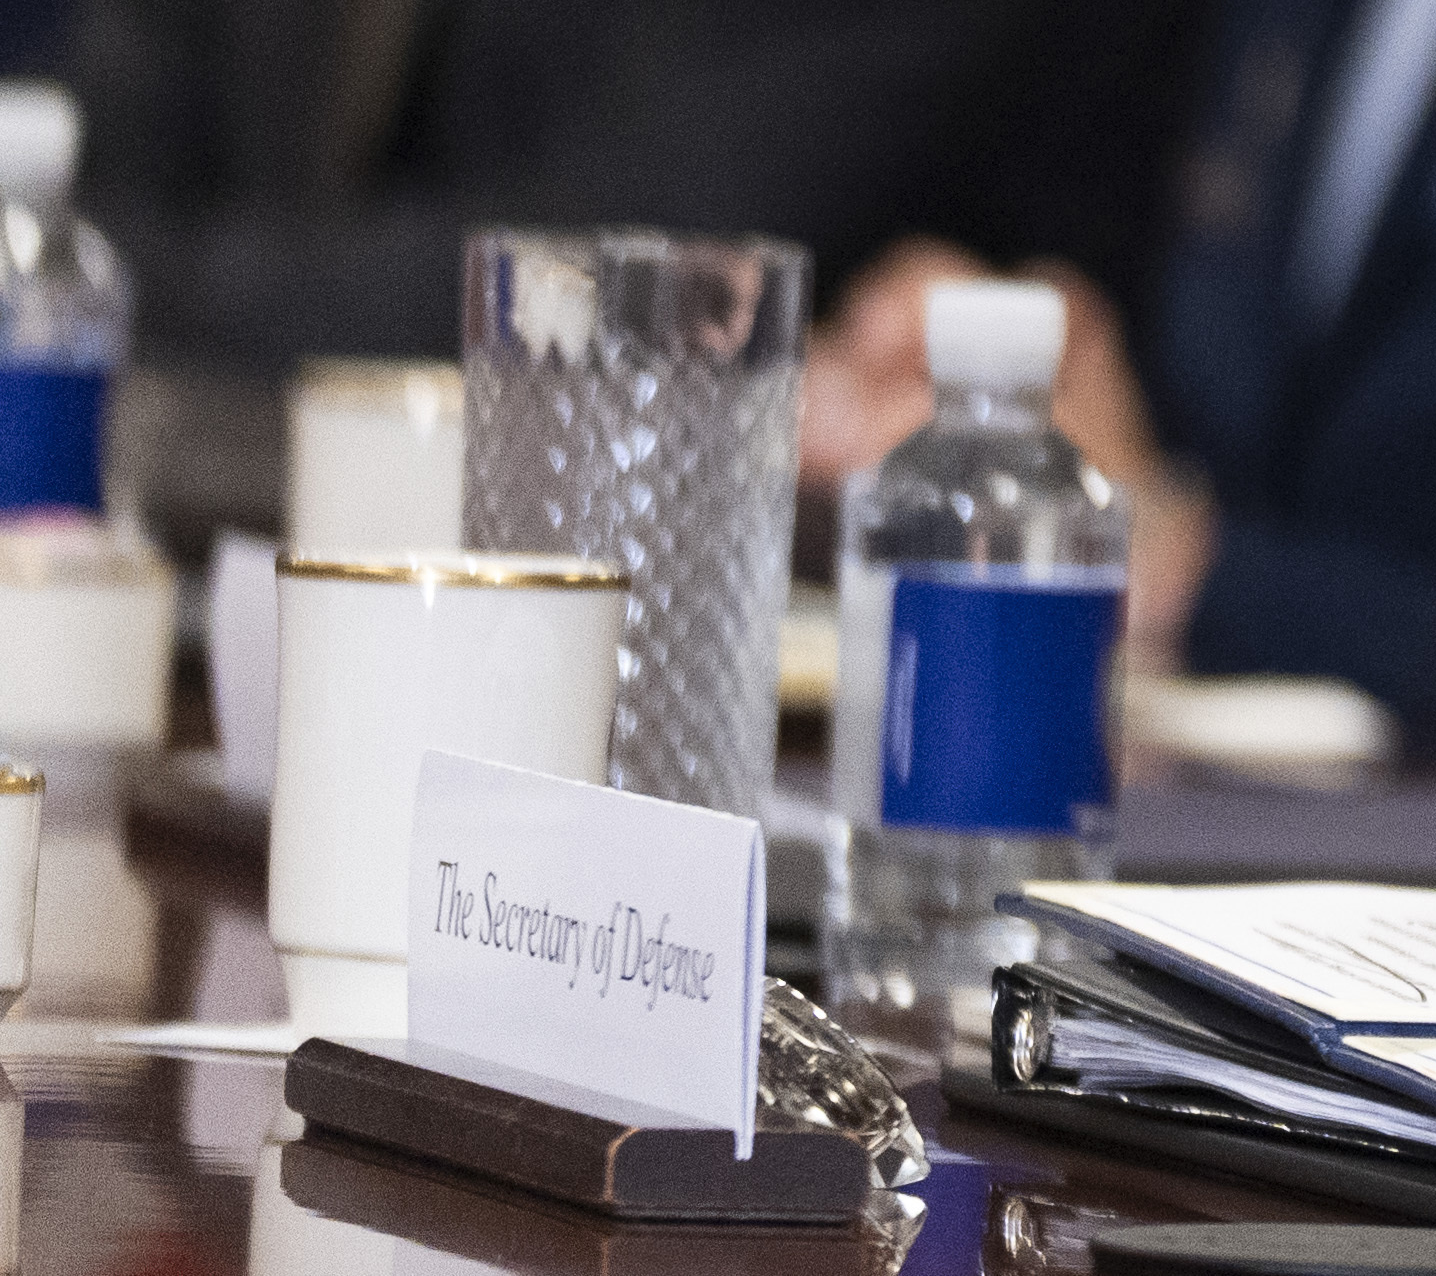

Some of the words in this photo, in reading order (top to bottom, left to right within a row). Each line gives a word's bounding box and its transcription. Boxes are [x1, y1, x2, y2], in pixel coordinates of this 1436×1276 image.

[435, 860, 474, 941] The
[479, 871, 587, 990] Secretary
[592, 901, 622, 998] of
[620, 906, 715, 1012] Defense
